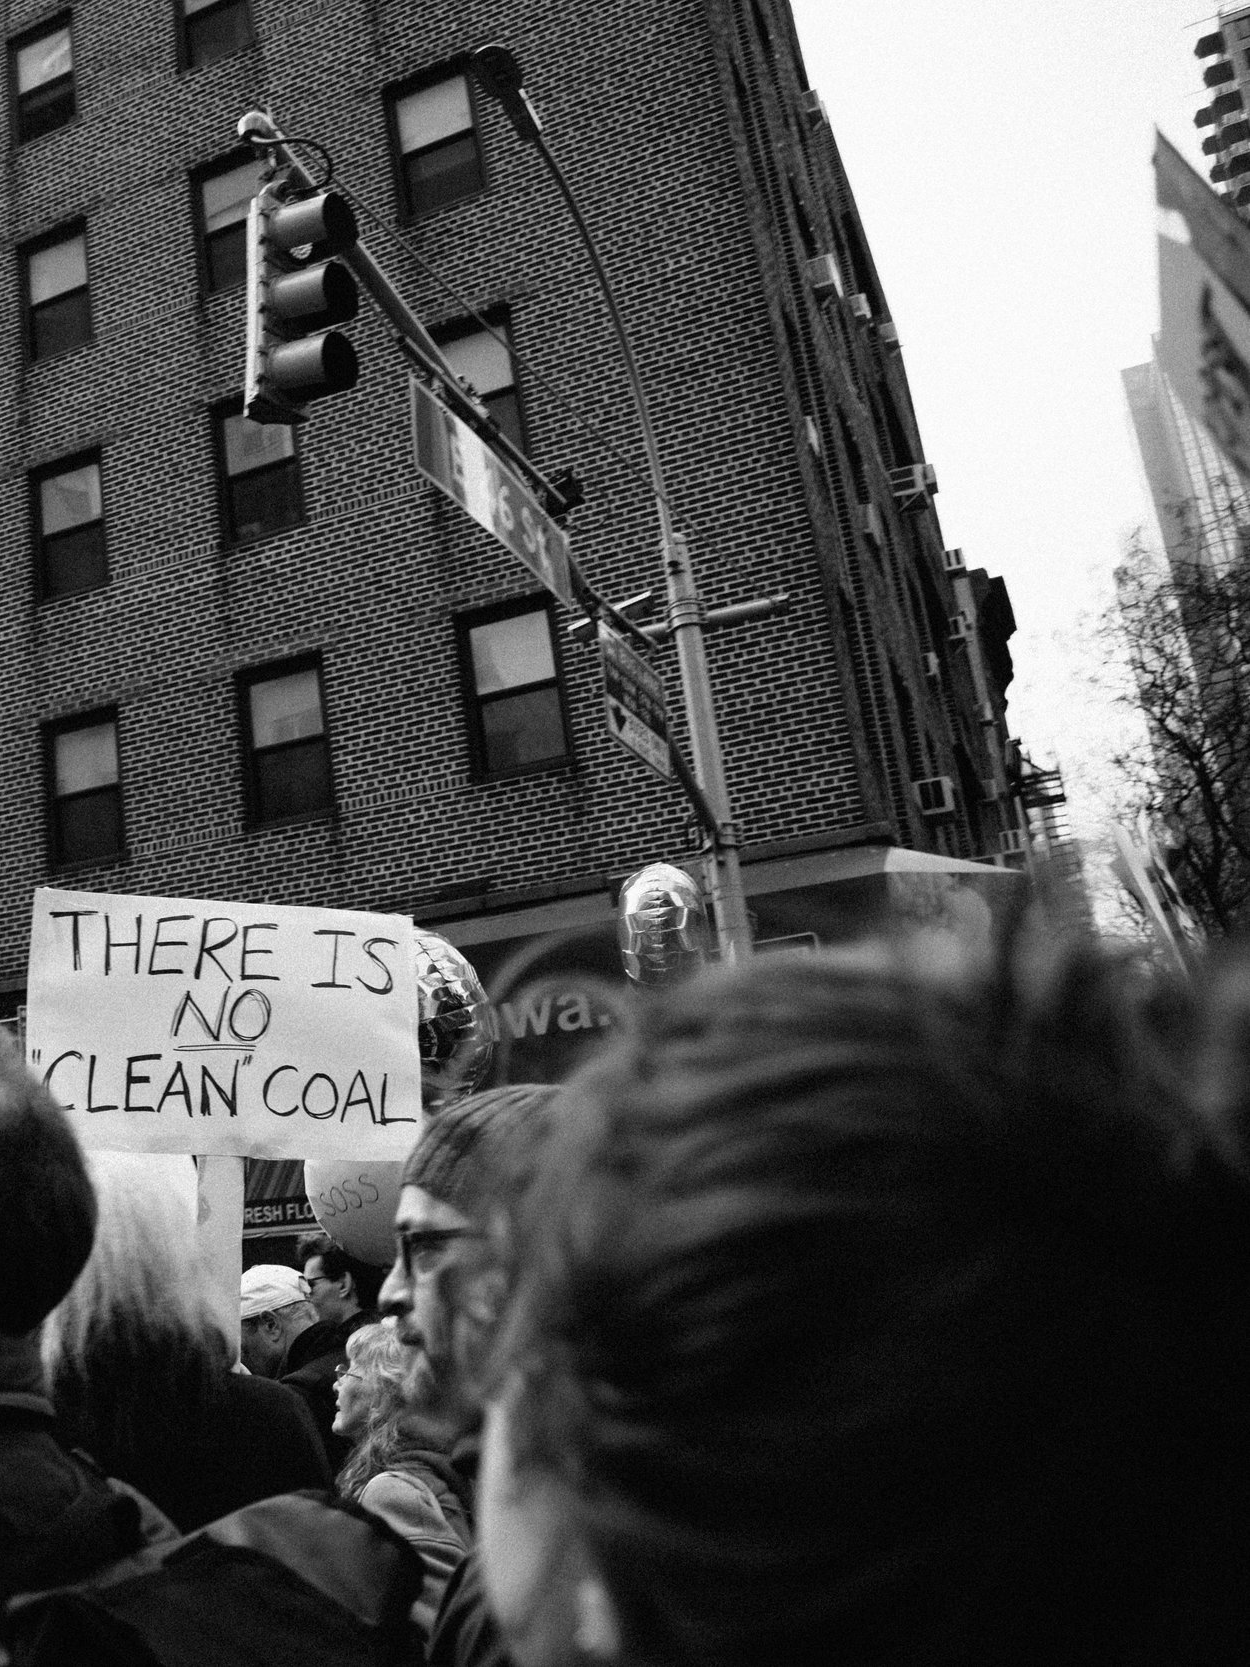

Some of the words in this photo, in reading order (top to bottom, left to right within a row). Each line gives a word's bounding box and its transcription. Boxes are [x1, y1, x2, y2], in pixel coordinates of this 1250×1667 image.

[50, 910, 280, 982] THERE
[311, 929, 399, 995] IS
[171, 986, 272, 1042] NO
[262, 1064, 417, 1126] COAL
